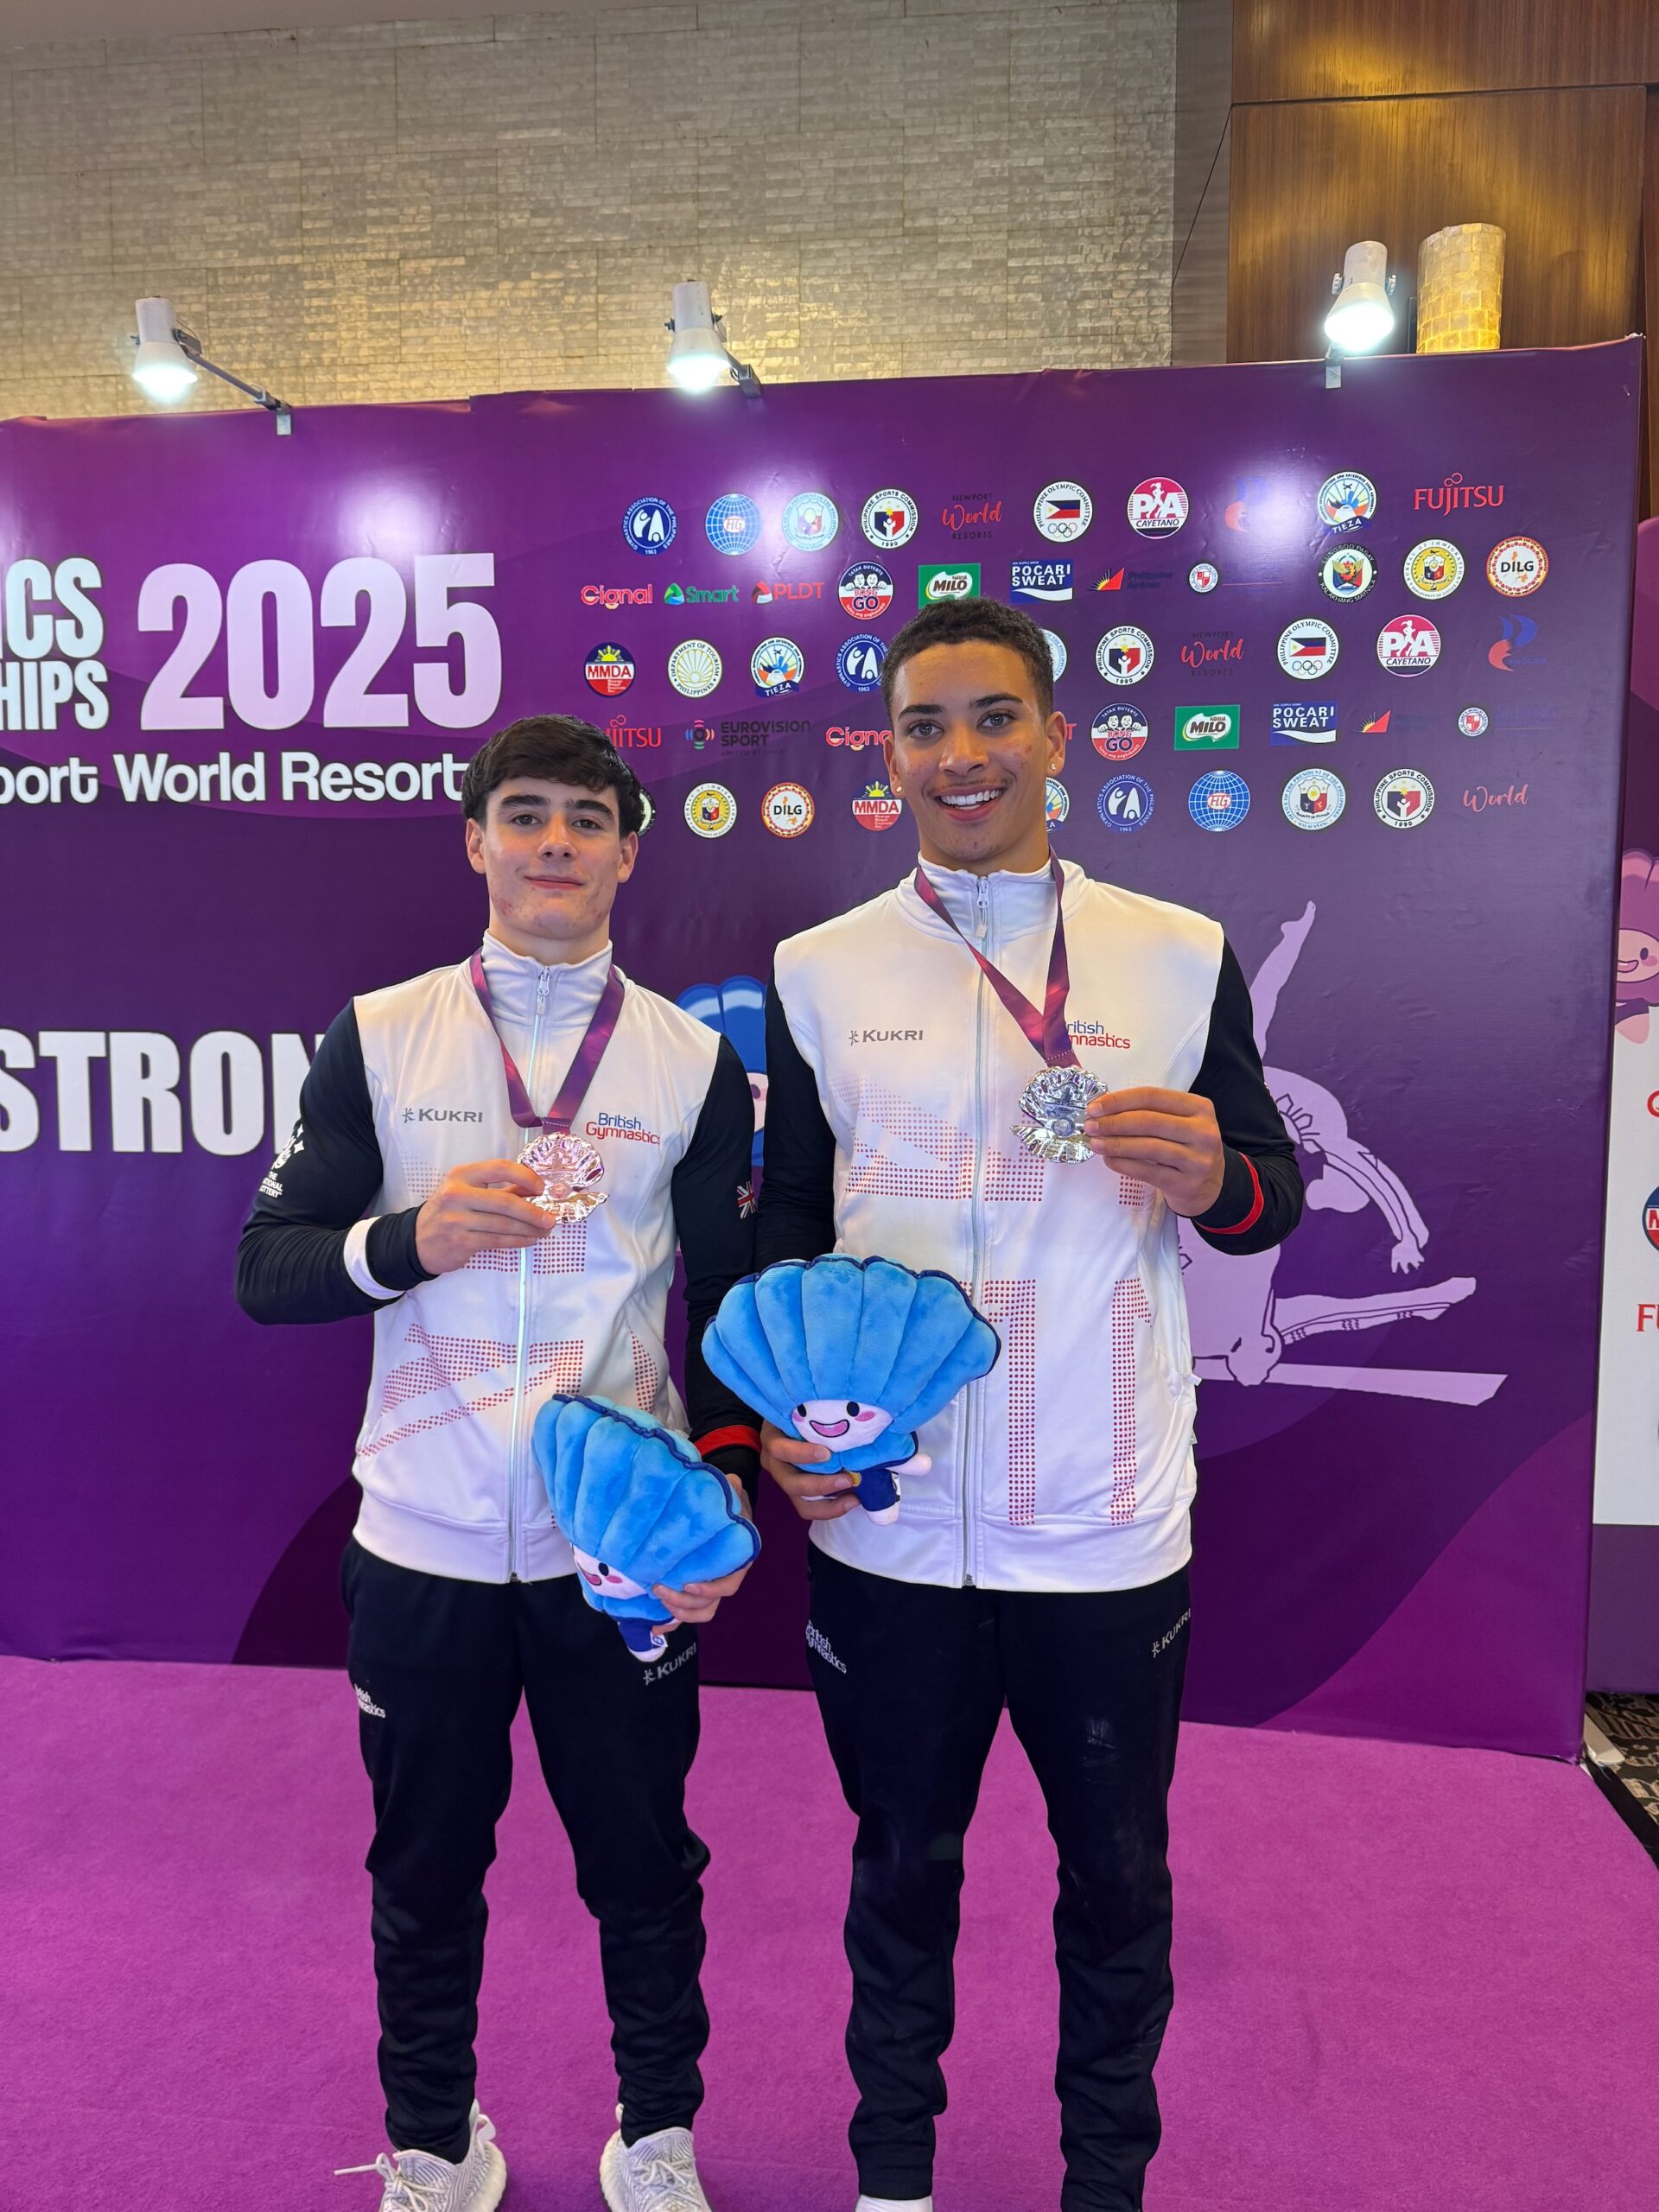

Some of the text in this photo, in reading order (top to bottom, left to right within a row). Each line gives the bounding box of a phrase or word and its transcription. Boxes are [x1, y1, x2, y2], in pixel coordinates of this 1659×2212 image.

[1413, 473, 1505, 516] FUJITSU
[863, 499, 875, 533] PHILIPPINE
[875, 491, 899, 499] SPORTS
[900, 494, 917, 531] COMMISSION
[1036, 484, 1090, 528] PHILIPPINE OLYMPIC COMMITTEE
[941, 501, 1003, 531] World
[1135, 518, 1180, 528] CAYETANO
[1332, 518, 1363, 534] TIEZA
[1012, 564, 1071, 576] POCARI
[1501, 561, 1535, 573] DILG
[933, 580, 968, 592] MILO
[1012, 575, 1066, 587] SWEAT
[580, 584, 653, 609] Cignal
[686, 585, 741, 604] Smart
[773, 582, 825, 601] PLDT
[854, 588, 878, 597] BONG
[0, 557, 105, 659] CS
[853, 595, 879, 611] GO
[138, 553, 502, 730] 2025
[841, 633, 873, 653] ASSOCIATION
[1096, 627, 1153, 671] PHILIPPINE SPORTS COMMISSION
[1281, 620, 1337, 666] PHILIPPINE OLYMPIC COMMITTEE
[671, 642, 696, 677] DEPARTMENT
[706, 647, 720, 677] TOURISM
[1180, 638, 1245, 668] World
[1386, 658, 1432, 666] CAYETANO
[588, 664, 632, 678] MMDA
[836, 652, 851, 688] GYMNASTICS
[676, 682, 715, 696] PHILIPPINES
[765, 683, 791, 696] TIEZA
[1273, 706, 1334, 718] POCARI
[1190, 721, 1226, 734] MILO
[1272, 716, 1329, 728] SWEAT
[721, 734, 769, 747] SPORT
[1107, 729, 1132, 738] BONG
[1105, 737, 1133, 753] GO
[112, 751, 267, 803] World
[1101, 774, 1136, 794] ASSOCIATION
[1143, 782, 1152, 794] THE
[1375, 771, 1433, 813] PHILIPPINE SPORTS COMMISSION
[854, 800, 899, 813] MMDA
[1463, 785, 1529, 812] World
[773, 804, 803, 816] DILG
[1096, 794, 1112, 828] GYMNASTICS
[1138, 793, 1155, 827] PHILIPPINES
[862, 1029, 924, 1043] KUKRI
[1066, 1020, 1104, 1035] ritish
[417, 1109, 483, 1123] KUKRI
[597, 1112, 642, 1131] British
[585, 1121, 660, 1145] Gymnastics
[1161, 1607, 1192, 1650] KUKRI
[657, 1642, 697, 1679] KUKRI
